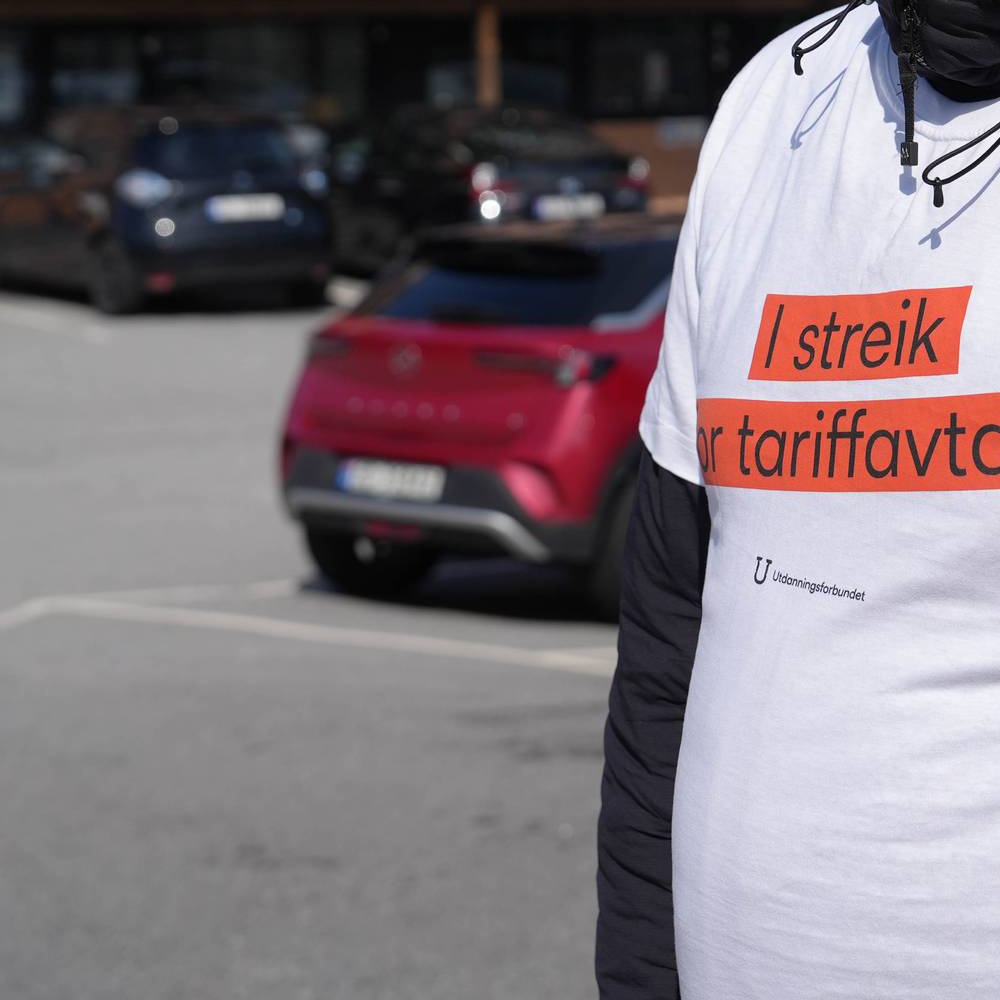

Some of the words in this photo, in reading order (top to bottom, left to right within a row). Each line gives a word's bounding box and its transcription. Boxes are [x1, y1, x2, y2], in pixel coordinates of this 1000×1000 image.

[764, 303, 785, 369] I
[793, 297, 945, 371] streik
[772, 569, 866, 602] Utdanningsforbundet
